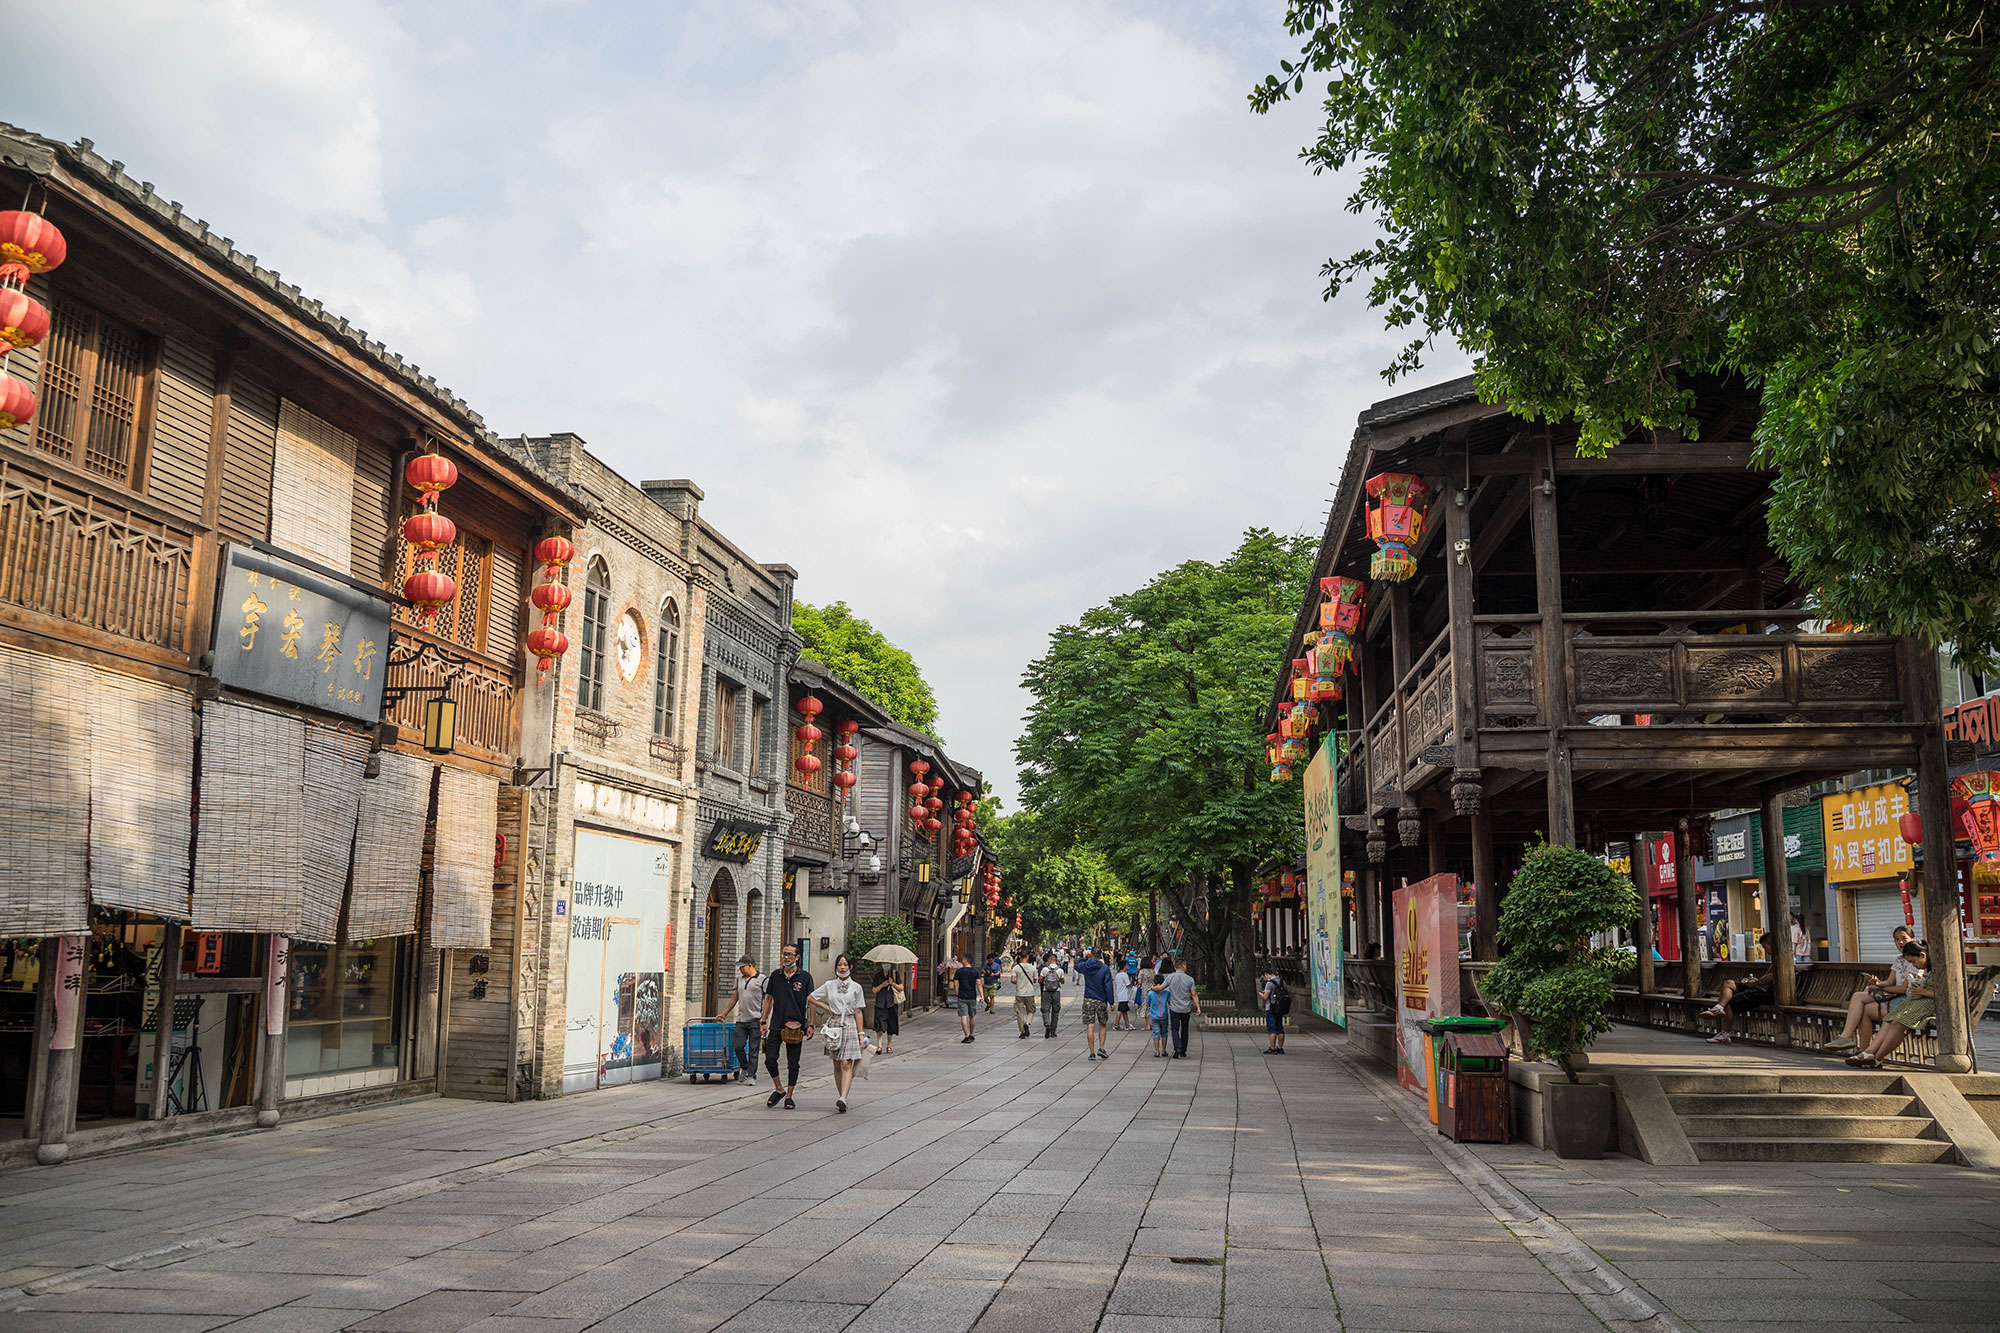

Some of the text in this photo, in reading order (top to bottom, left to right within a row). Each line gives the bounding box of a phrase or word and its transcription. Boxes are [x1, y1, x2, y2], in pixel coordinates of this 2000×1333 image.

[240, 592, 377, 680] 宇宏琴行
[574, 881, 623, 908] 品牌升级中
